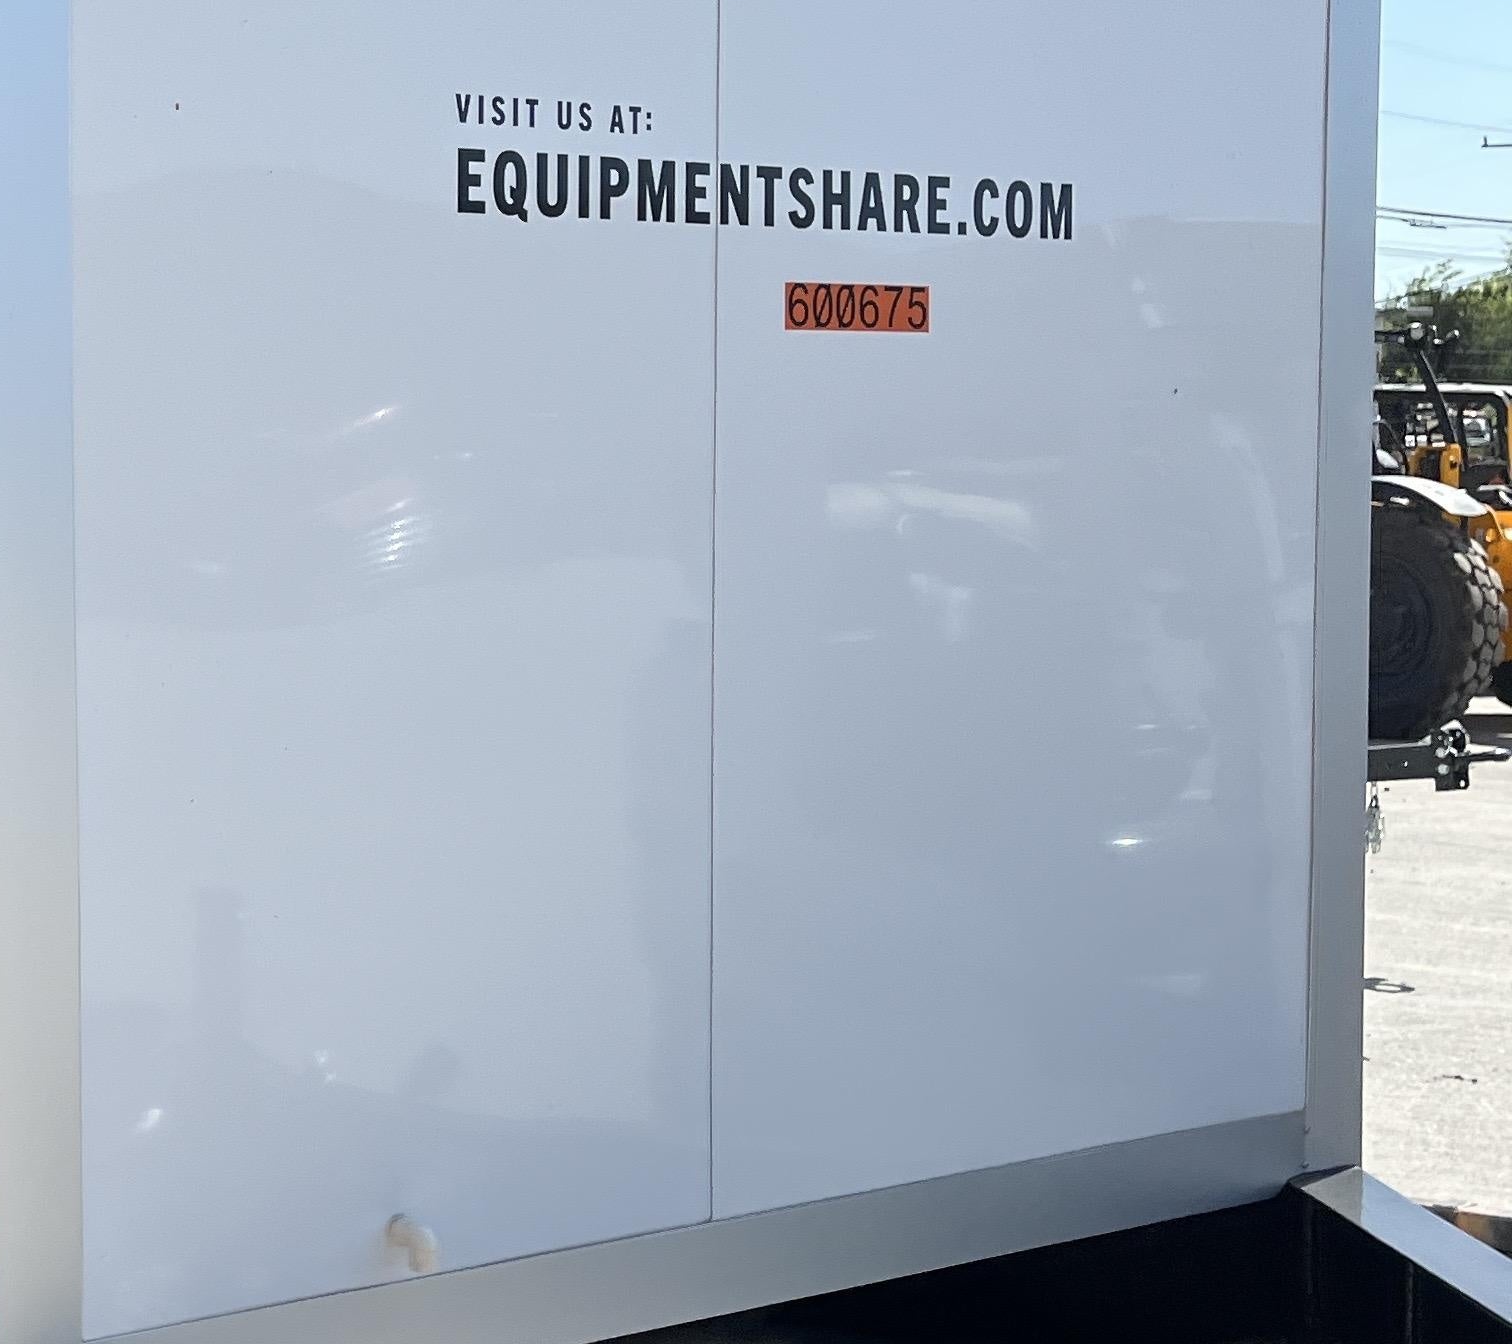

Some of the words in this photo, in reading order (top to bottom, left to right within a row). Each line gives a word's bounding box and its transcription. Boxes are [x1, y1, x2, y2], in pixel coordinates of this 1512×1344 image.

[455, 93, 540, 129] VISIT
[557, 100, 593, 133] US
[609, 104, 654, 135] AT:
[456, 147, 1074, 241] EQUIPMENTSHARE.COM
[788, 282, 928, 330] 600675
